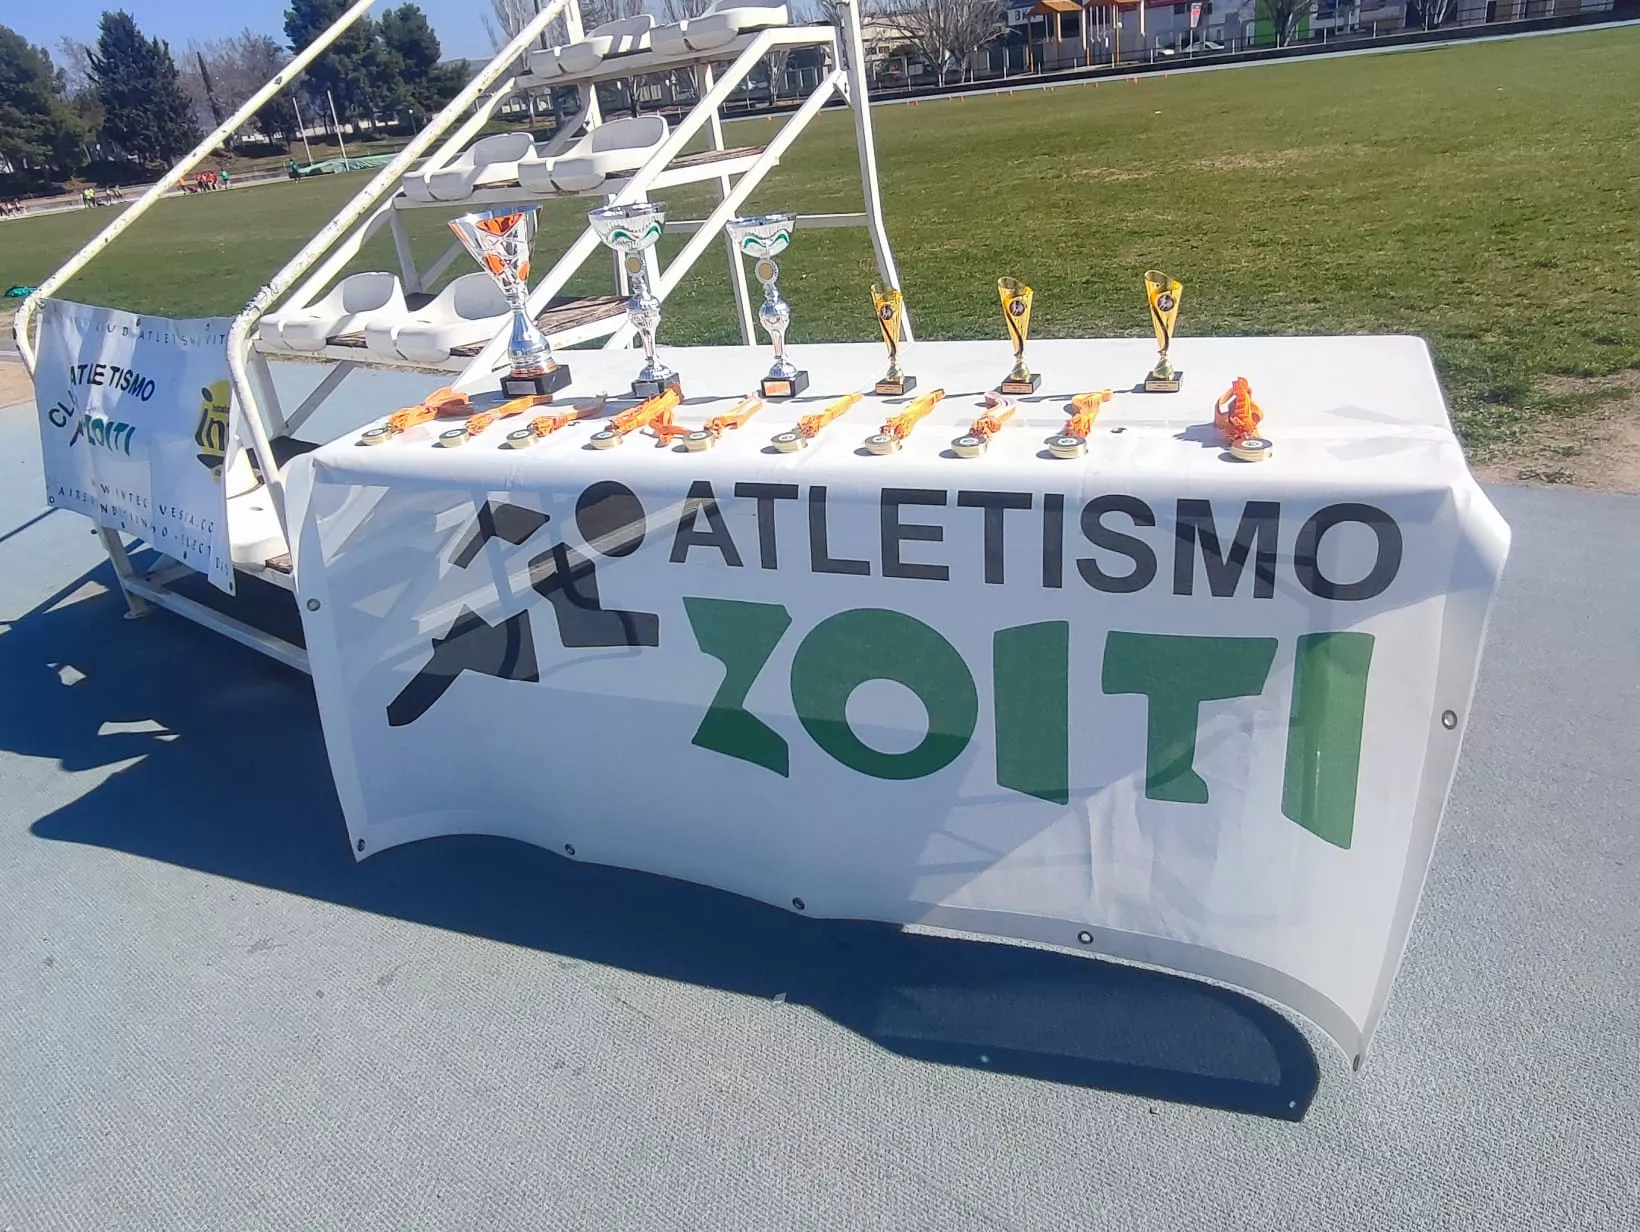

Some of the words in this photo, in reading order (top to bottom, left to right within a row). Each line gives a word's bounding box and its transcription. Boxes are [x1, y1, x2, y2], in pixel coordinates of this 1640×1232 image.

[69, 363, 156, 402] ATLETISMO
[669, 480, 1403, 601] ATLETISMO
[682, 596, 1376, 851] ZOITI
